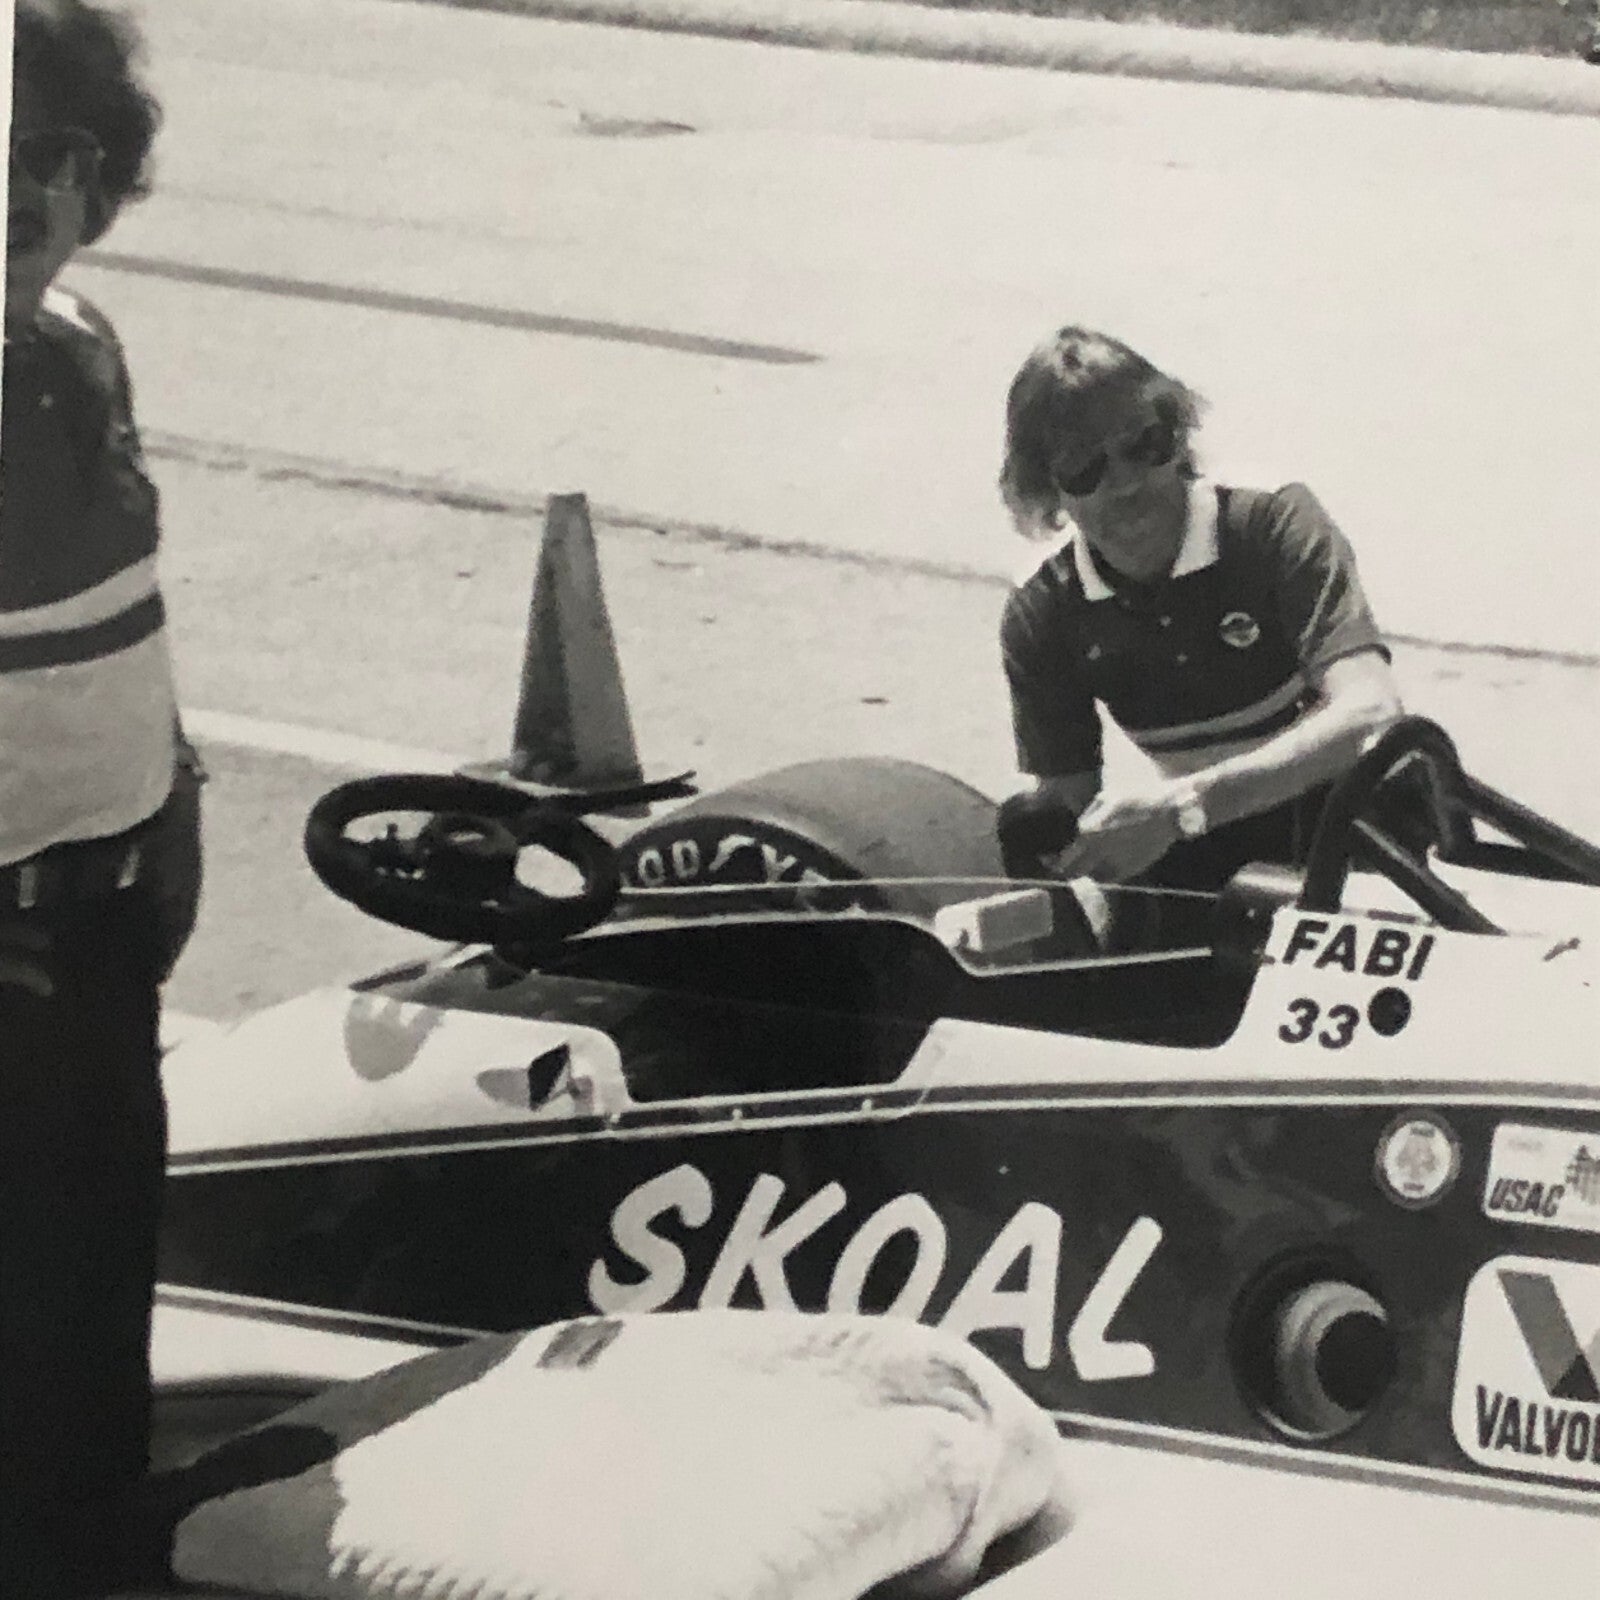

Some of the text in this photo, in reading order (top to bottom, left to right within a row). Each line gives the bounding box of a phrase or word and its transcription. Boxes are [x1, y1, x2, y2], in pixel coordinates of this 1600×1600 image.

[1281, 918, 1436, 981] FABI
[1277, 997, 1361, 1050] 33
[1488, 1177, 1566, 1218] USAC
[588, 1163, 1164, 1382] SKOAL
